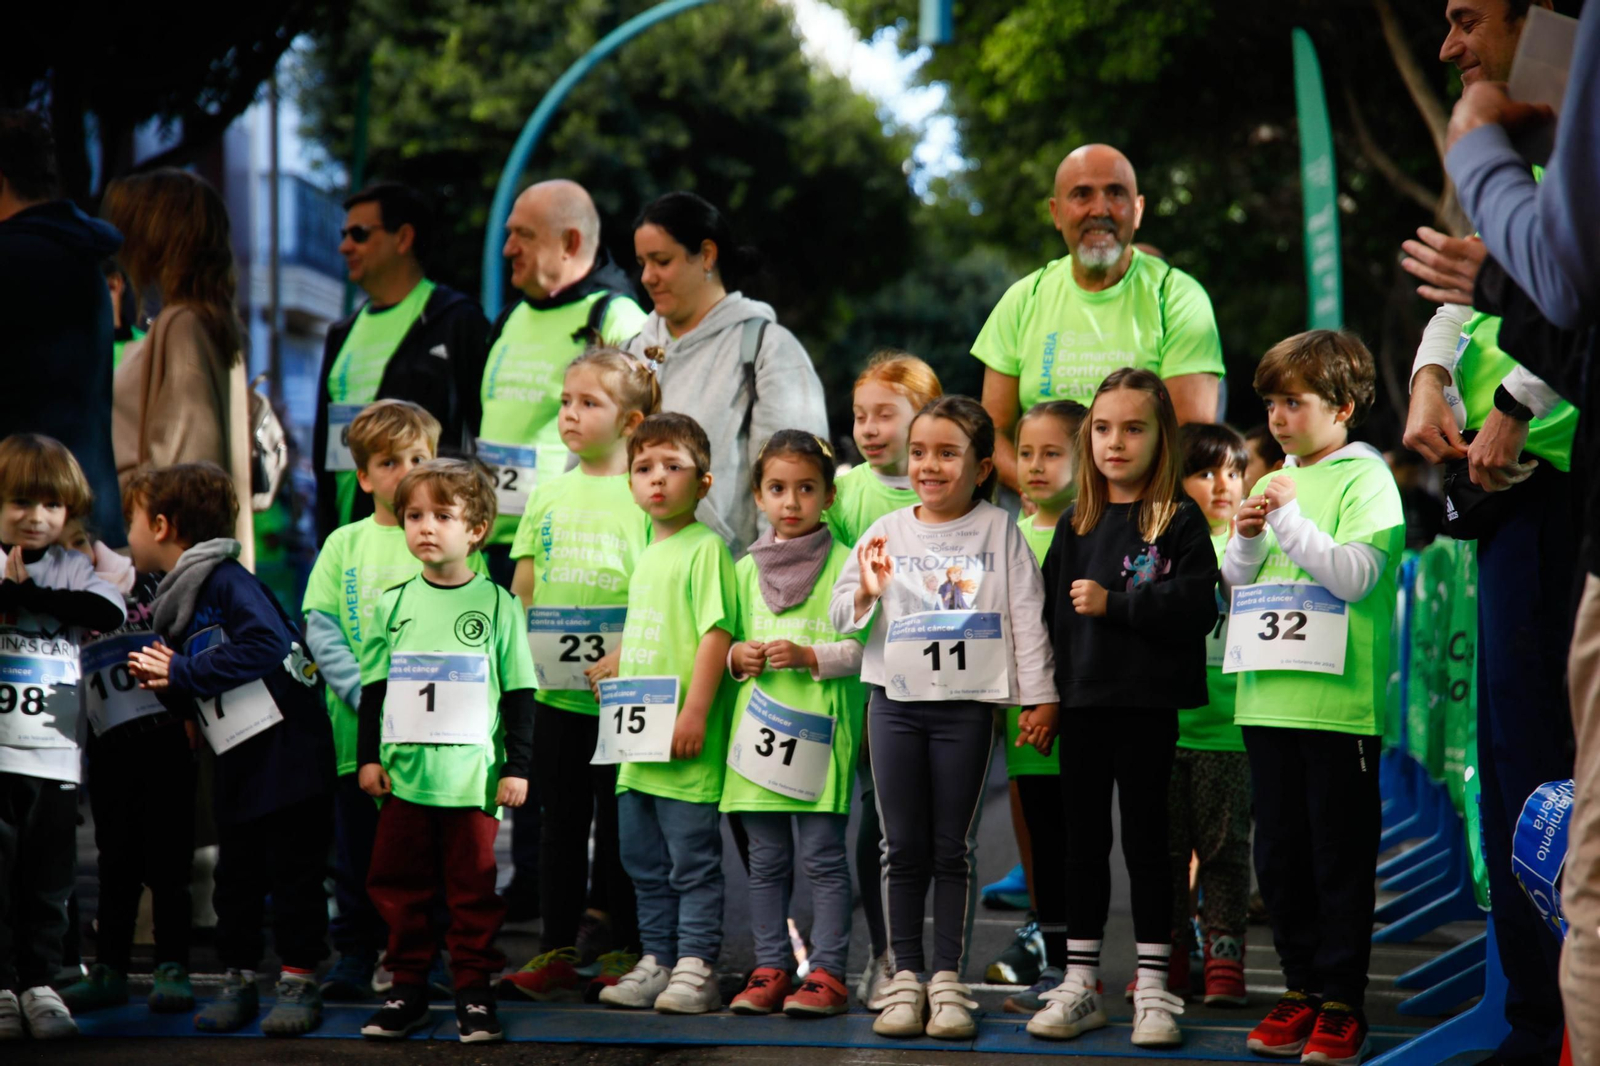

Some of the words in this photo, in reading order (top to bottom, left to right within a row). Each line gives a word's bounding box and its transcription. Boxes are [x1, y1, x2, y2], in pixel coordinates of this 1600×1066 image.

[1039, 332, 1058, 397] ALMERÍA
[551, 561, 623, 592] cáncer
[895, 553, 980, 574] FROZEN
[343, 567, 362, 642] ALMERÍA
[1236, 598, 1258, 607] contra
[1266, 594, 1294, 603] cáncer
[1237, 588, 1263, 598] Almería
[531, 610, 560, 618] Almería
[556, 618, 564, 626] el
[564, 618, 591, 627] cáncer
[754, 616, 773, 631] En
[1258, 611, 1308, 641] 32
[892, 627, 917, 636] contra
[917, 625, 926, 633] el
[927, 624, 955, 632] cáncer
[559, 634, 607, 663] 23
[923, 641, 966, 671] 11
[411, 665, 439, 673] cáncer
[0, 683, 45, 716] 98
[418, 683, 436, 712] 1
[614, 706, 646, 735] 15
[767, 713, 792, 727] cáncer
[755, 727, 798, 767] 31
